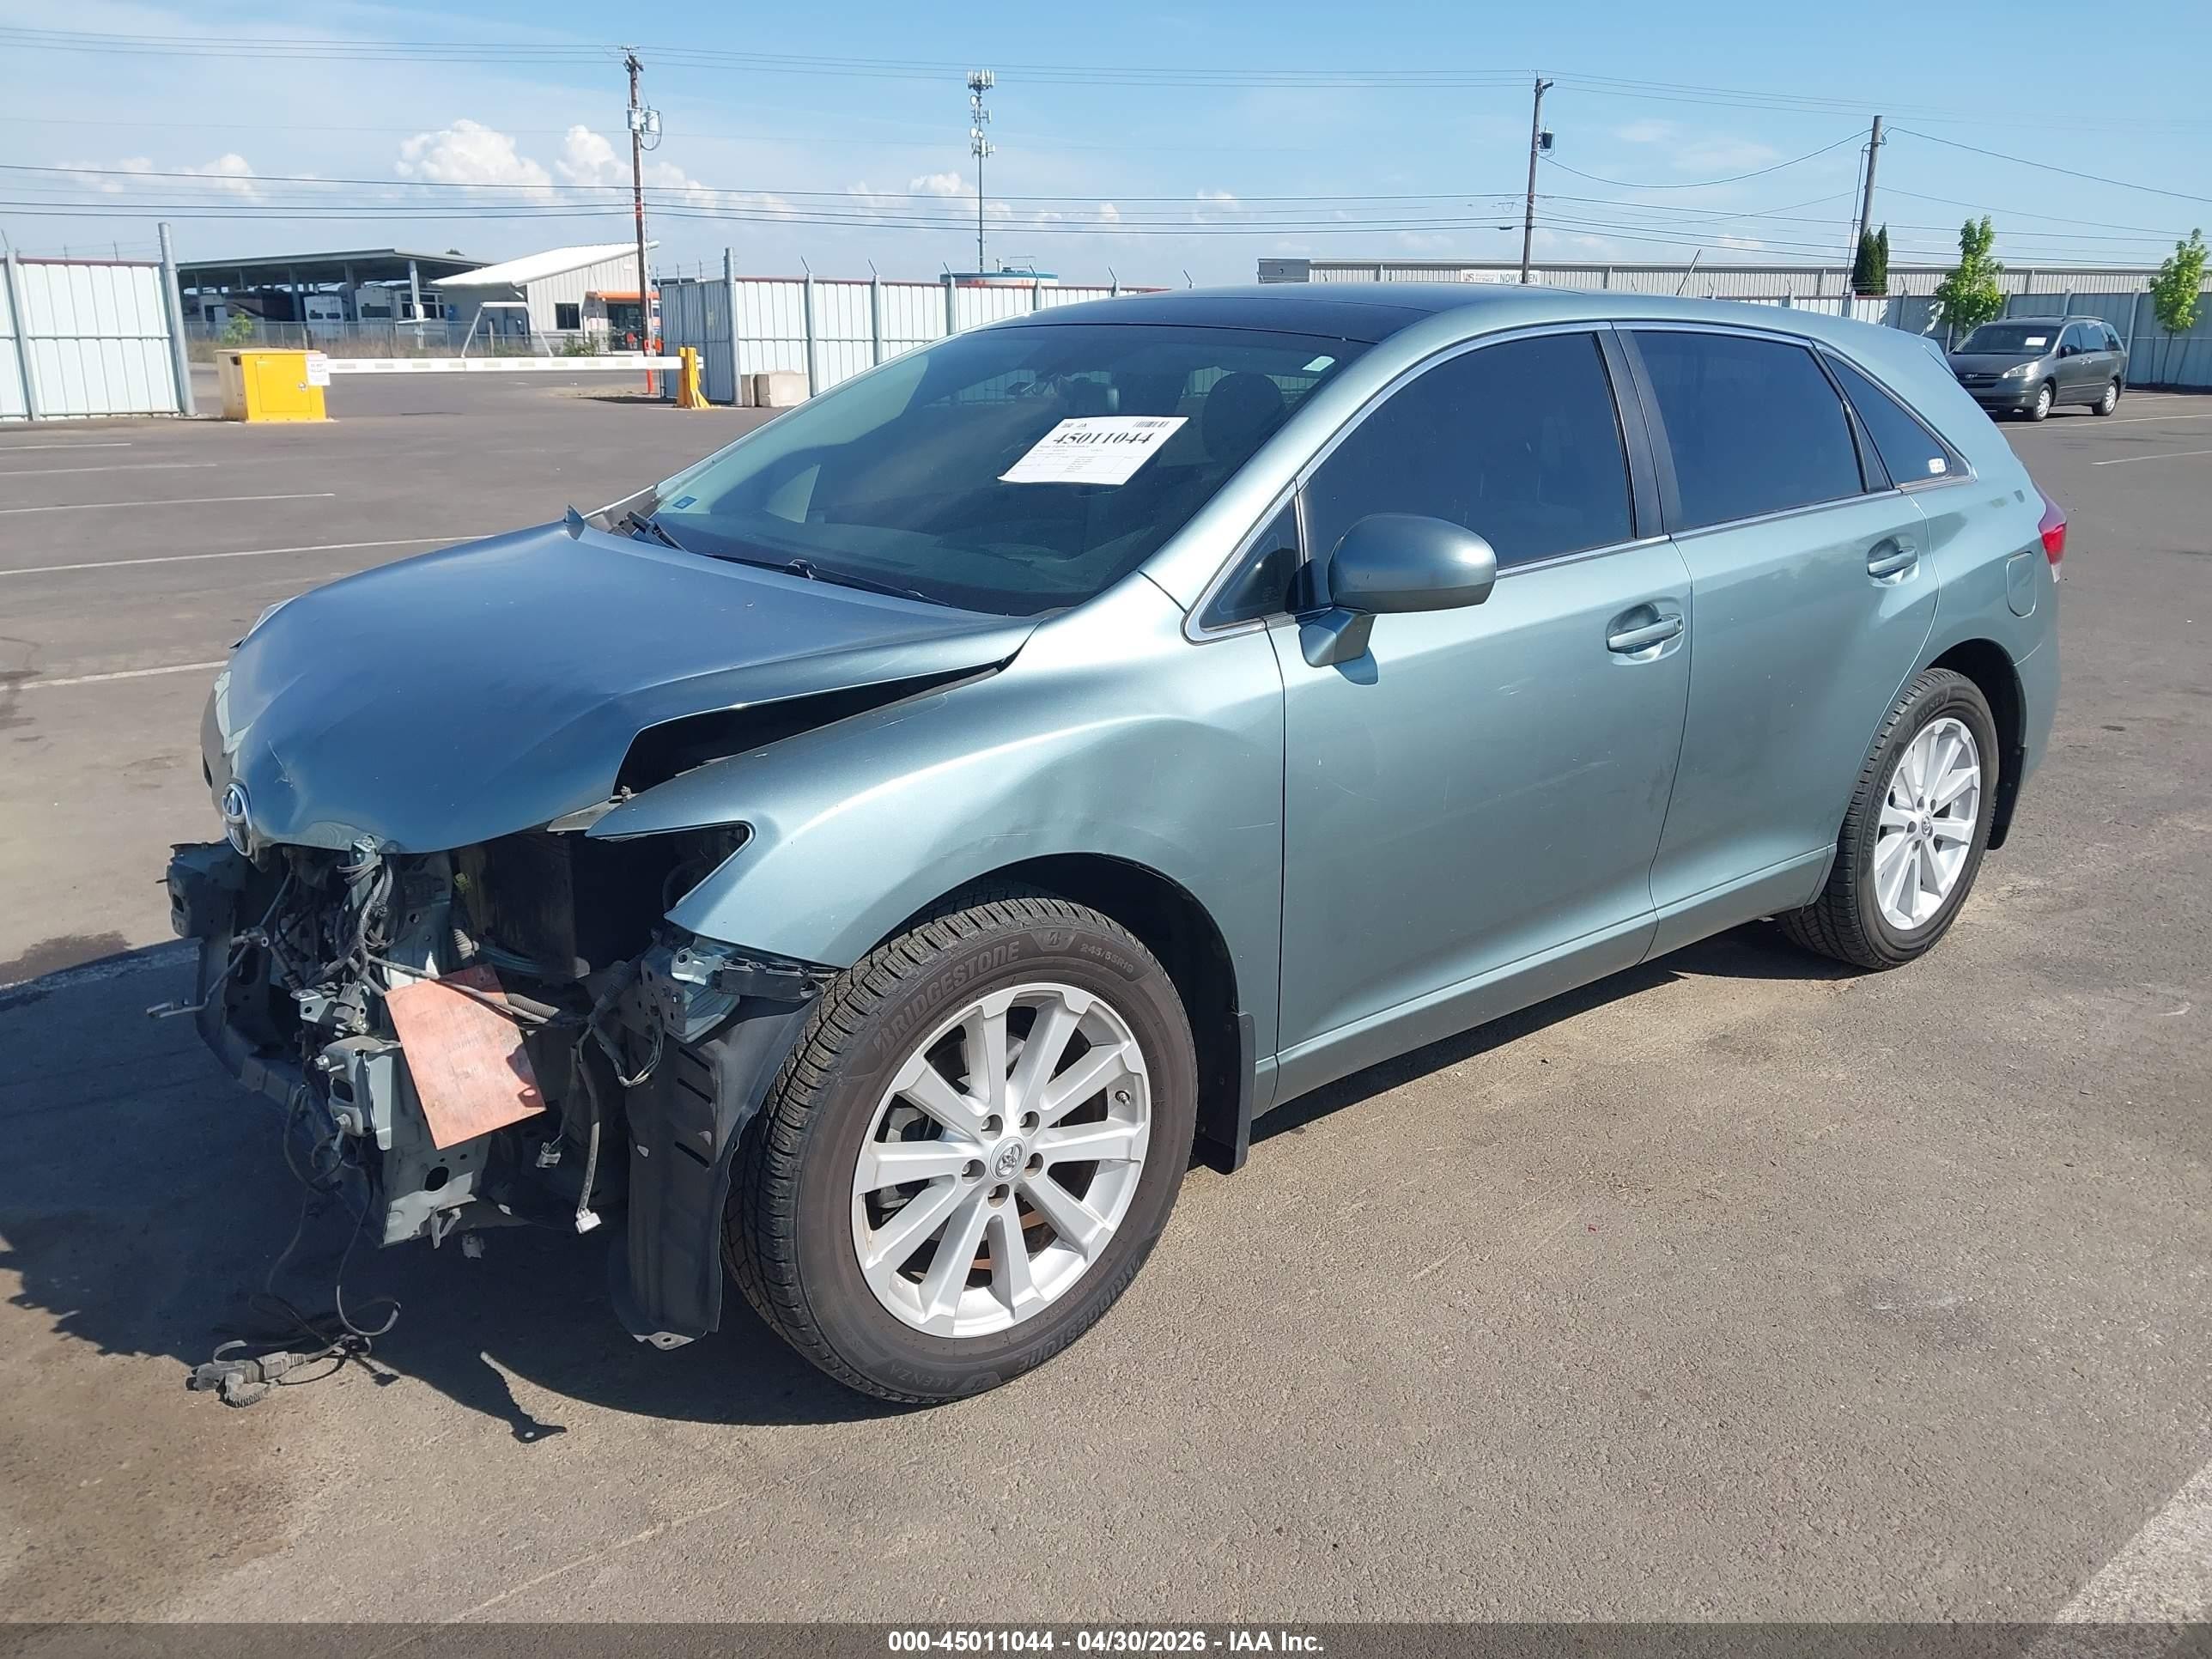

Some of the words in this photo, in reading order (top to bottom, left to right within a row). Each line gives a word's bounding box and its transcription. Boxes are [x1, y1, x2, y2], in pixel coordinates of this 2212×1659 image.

[1499, 273, 1517, 283] NOW
[1518, 273, 1538, 283] OEN
[1052, 432, 1155, 444] 45011044
[1862, 750, 1899, 858] BRIDGESTONE
[873, 941, 1020, 1052] BRIDGESTONE
